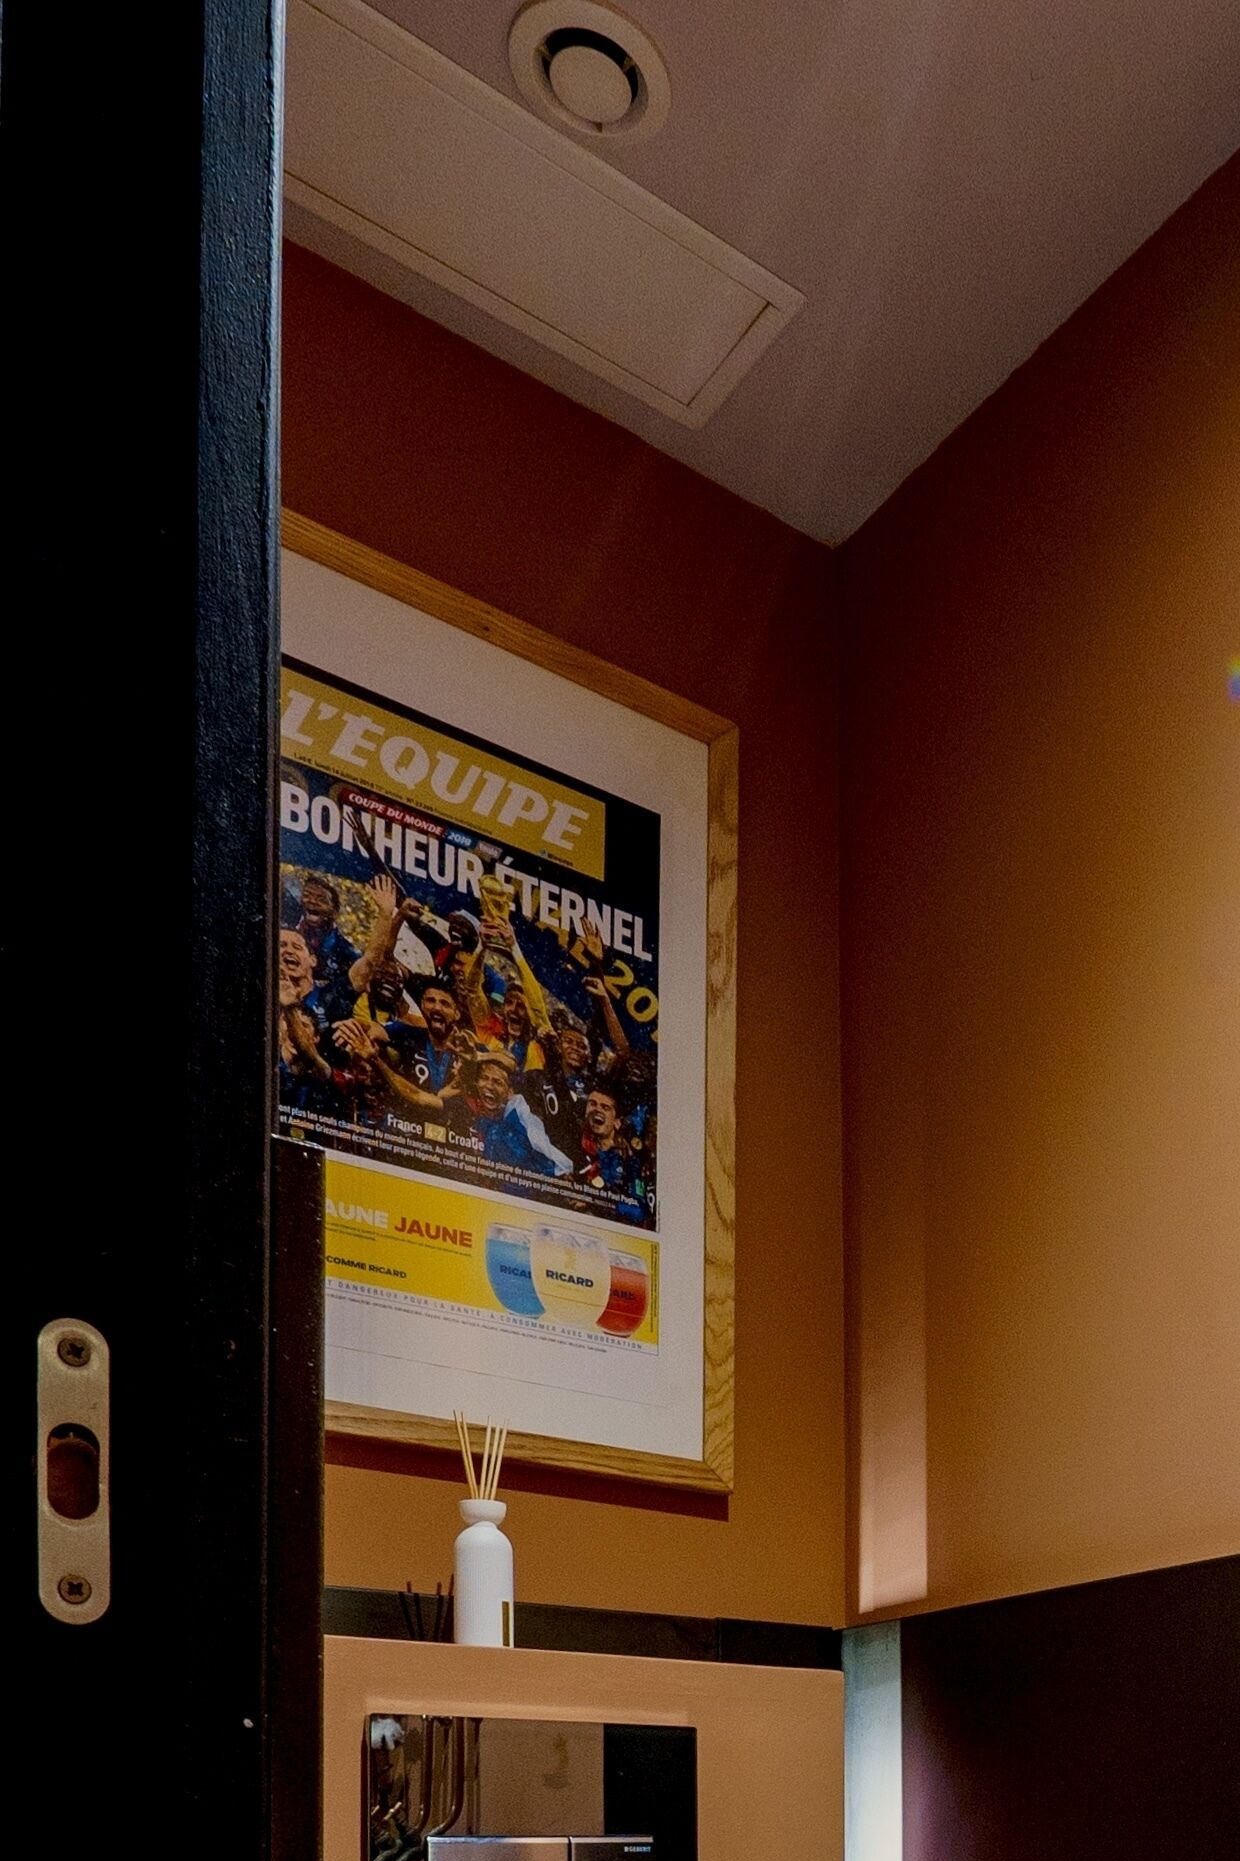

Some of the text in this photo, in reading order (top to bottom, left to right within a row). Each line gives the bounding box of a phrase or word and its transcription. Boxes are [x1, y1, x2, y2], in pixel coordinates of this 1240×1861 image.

[349, 793, 386, 813] COUPE
[386, 807, 404, 820] DU
[404, 814, 444, 836] MONDE
[280, 780, 484, 900] BONHEUR
[495, 856, 653, 962] ÉTERNEL
[604, 960, 658, 1040] 20
[279, 1104, 290, 1114] ont
[387, 1114, 422, 1135] France
[448, 1131, 485, 1152] Croatie
[325, 1198, 388, 1229] AUNE
[394, 1217, 473, 1248] JAUNE
[326, 1255, 407, 1279] COMME RICARD
[500, 1265, 531, 1279] RICA
[545, 1269, 594, 1288] RICARD
[338, 1281, 397, 1299] DANGEREUX
[403, 1295, 428, 1305] POUR
[561, 1327, 582, 1338] AVEC
